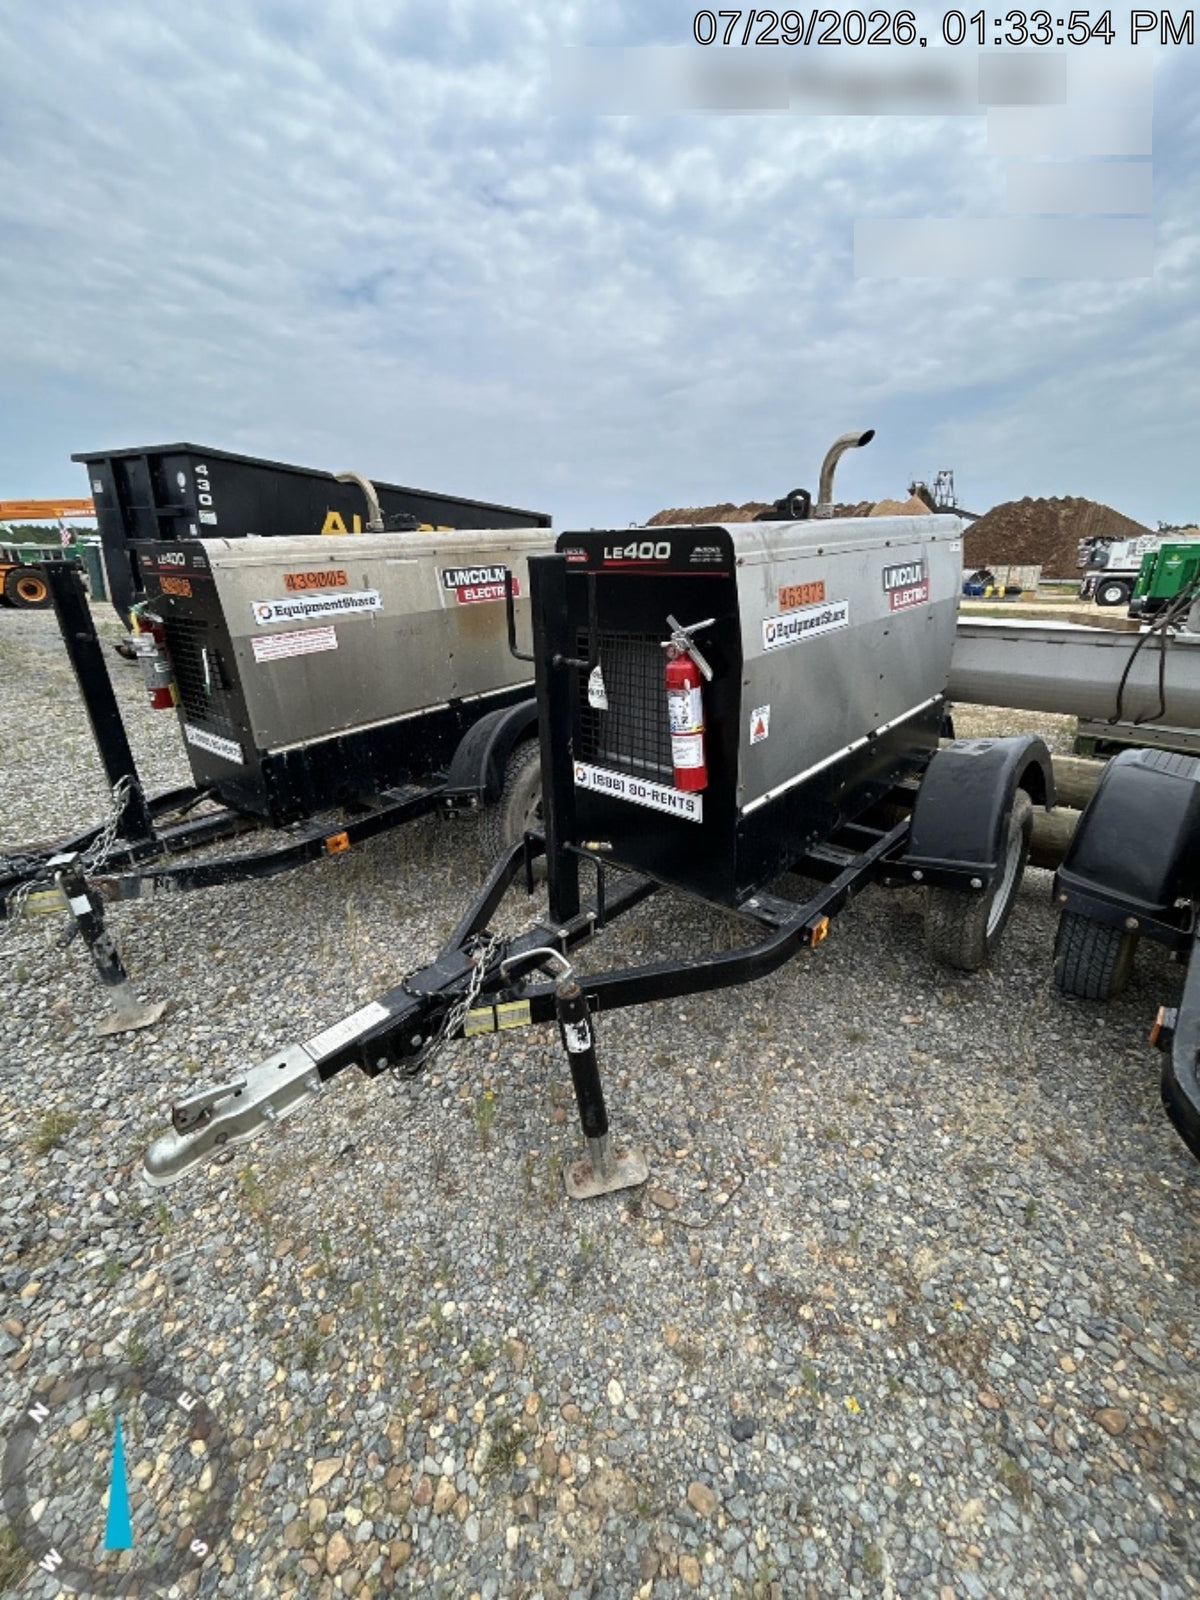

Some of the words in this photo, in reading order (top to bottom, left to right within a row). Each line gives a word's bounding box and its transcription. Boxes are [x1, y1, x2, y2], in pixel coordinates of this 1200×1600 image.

[603, 541, 671, 560] LE400
[445, 566, 506, 587] LINCOLN
[884, 564, 923, 590] LINCOLN
[464, 584, 515, 601] ELECTR
[892, 585, 928, 608] ELECTRIC
[273, 596, 378, 619] EquipmentShare
[776, 608, 847, 639] EquipmentShare
